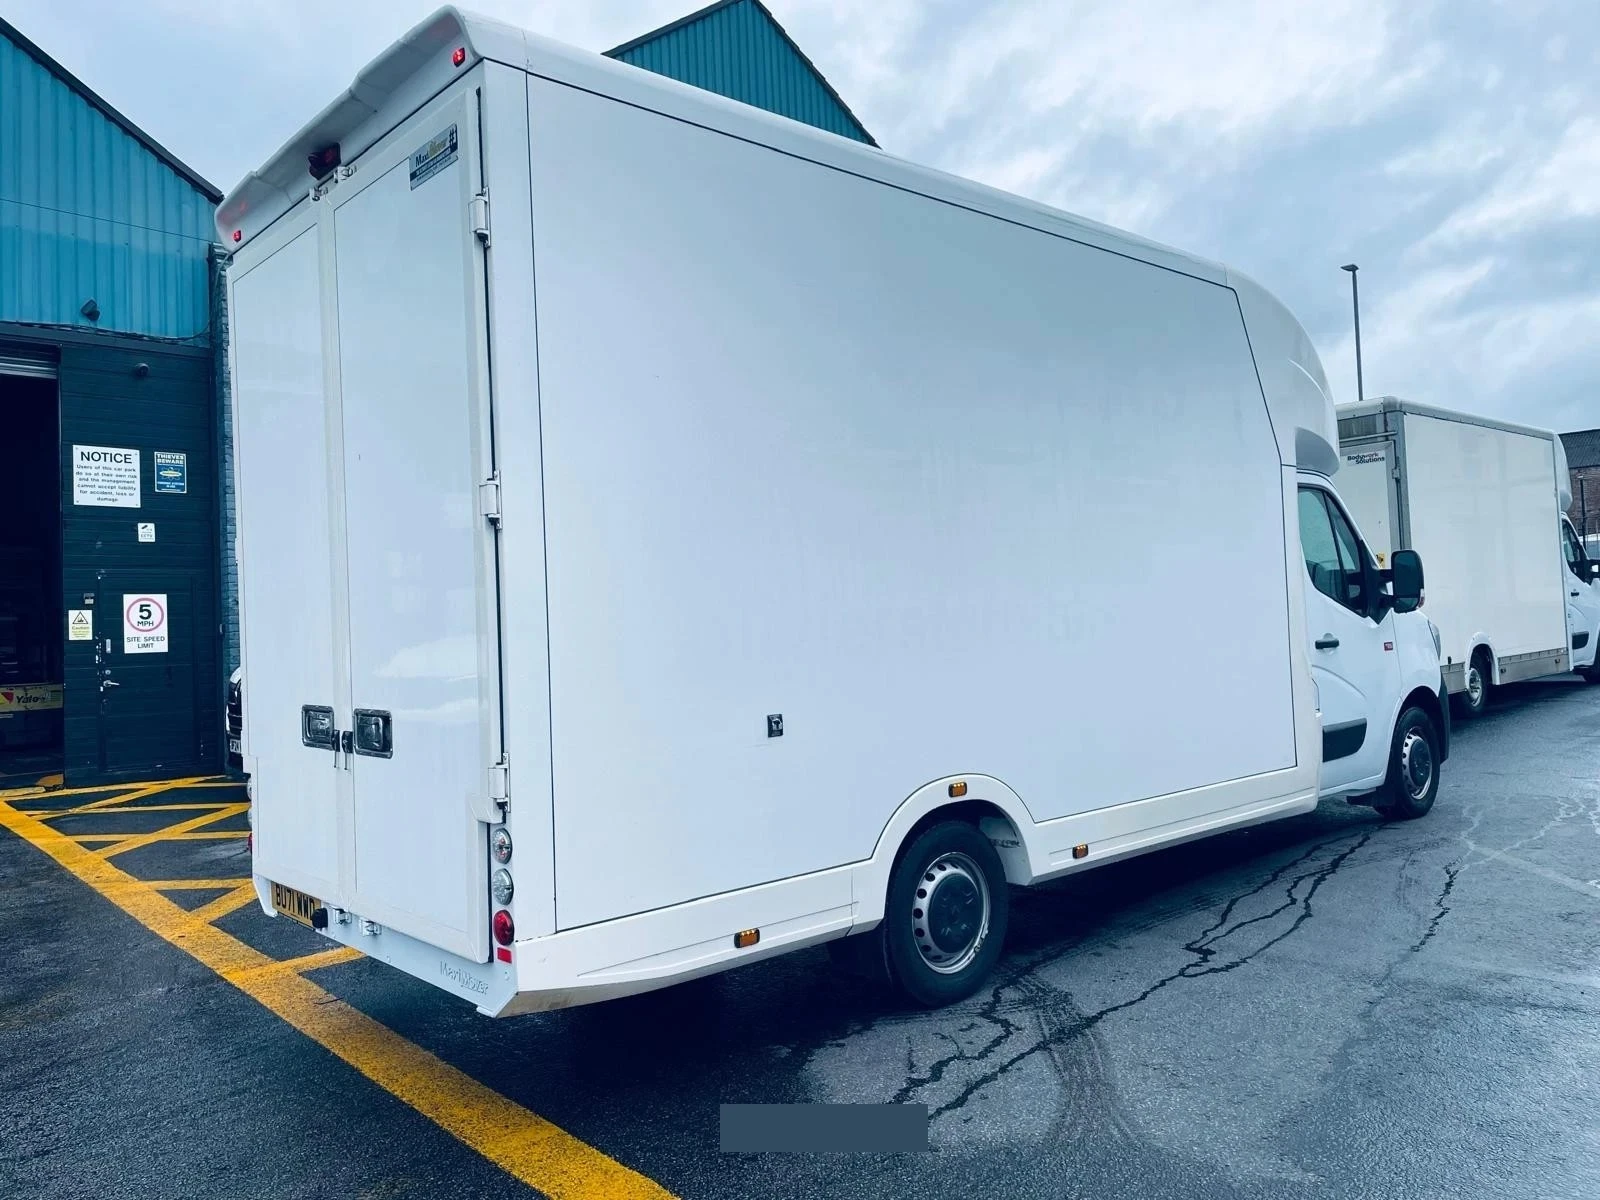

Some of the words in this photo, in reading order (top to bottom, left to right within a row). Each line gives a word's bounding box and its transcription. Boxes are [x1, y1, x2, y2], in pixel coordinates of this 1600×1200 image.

[81, 451, 132, 464] NOTICE
[1355, 456, 1385, 464] Solutions
[139, 604, 152, 620] 5
[275, 883, 295, 914] BU71
